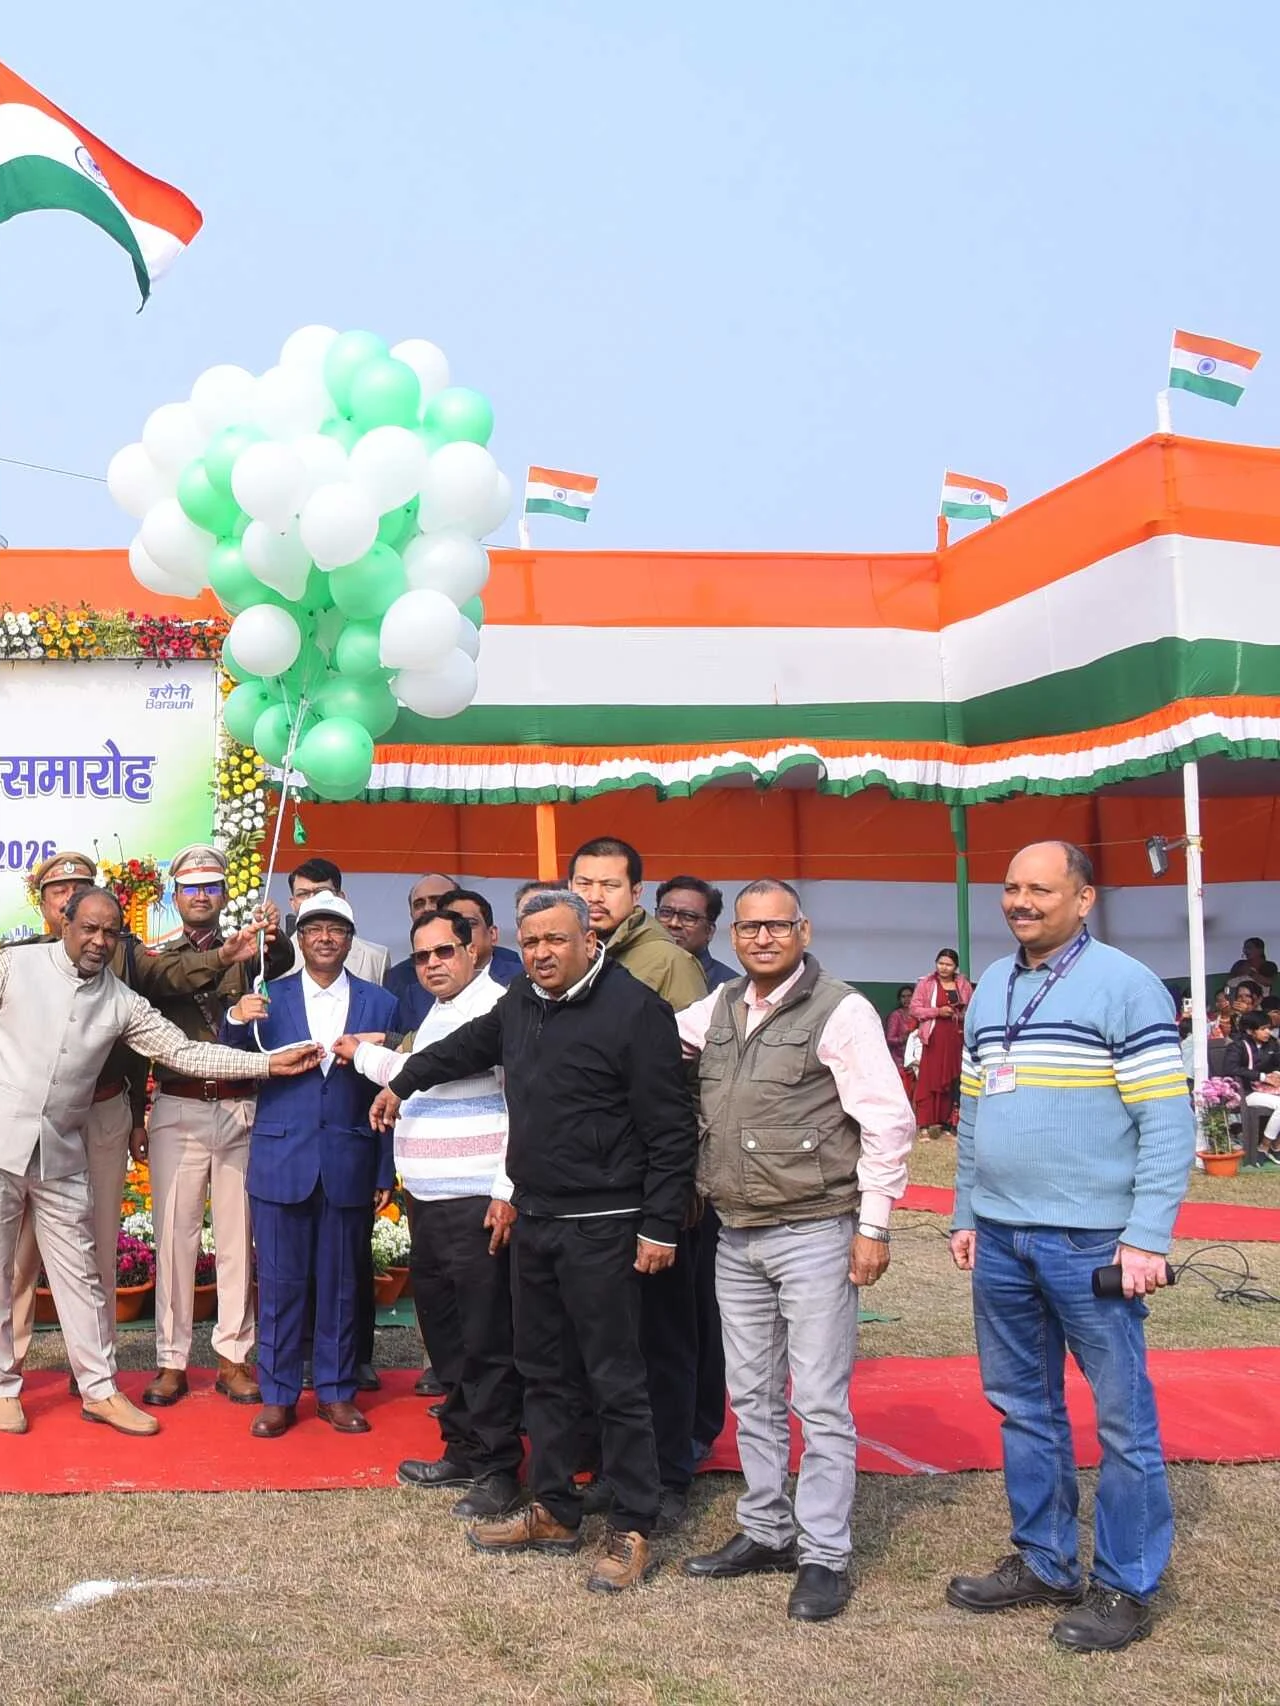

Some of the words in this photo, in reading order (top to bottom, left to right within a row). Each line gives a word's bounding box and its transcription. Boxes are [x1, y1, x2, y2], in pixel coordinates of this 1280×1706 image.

[148, 682, 193, 700] बरौनी
[145, 698, 194, 710] Barauni
[0, 738, 156, 801] समारोह
